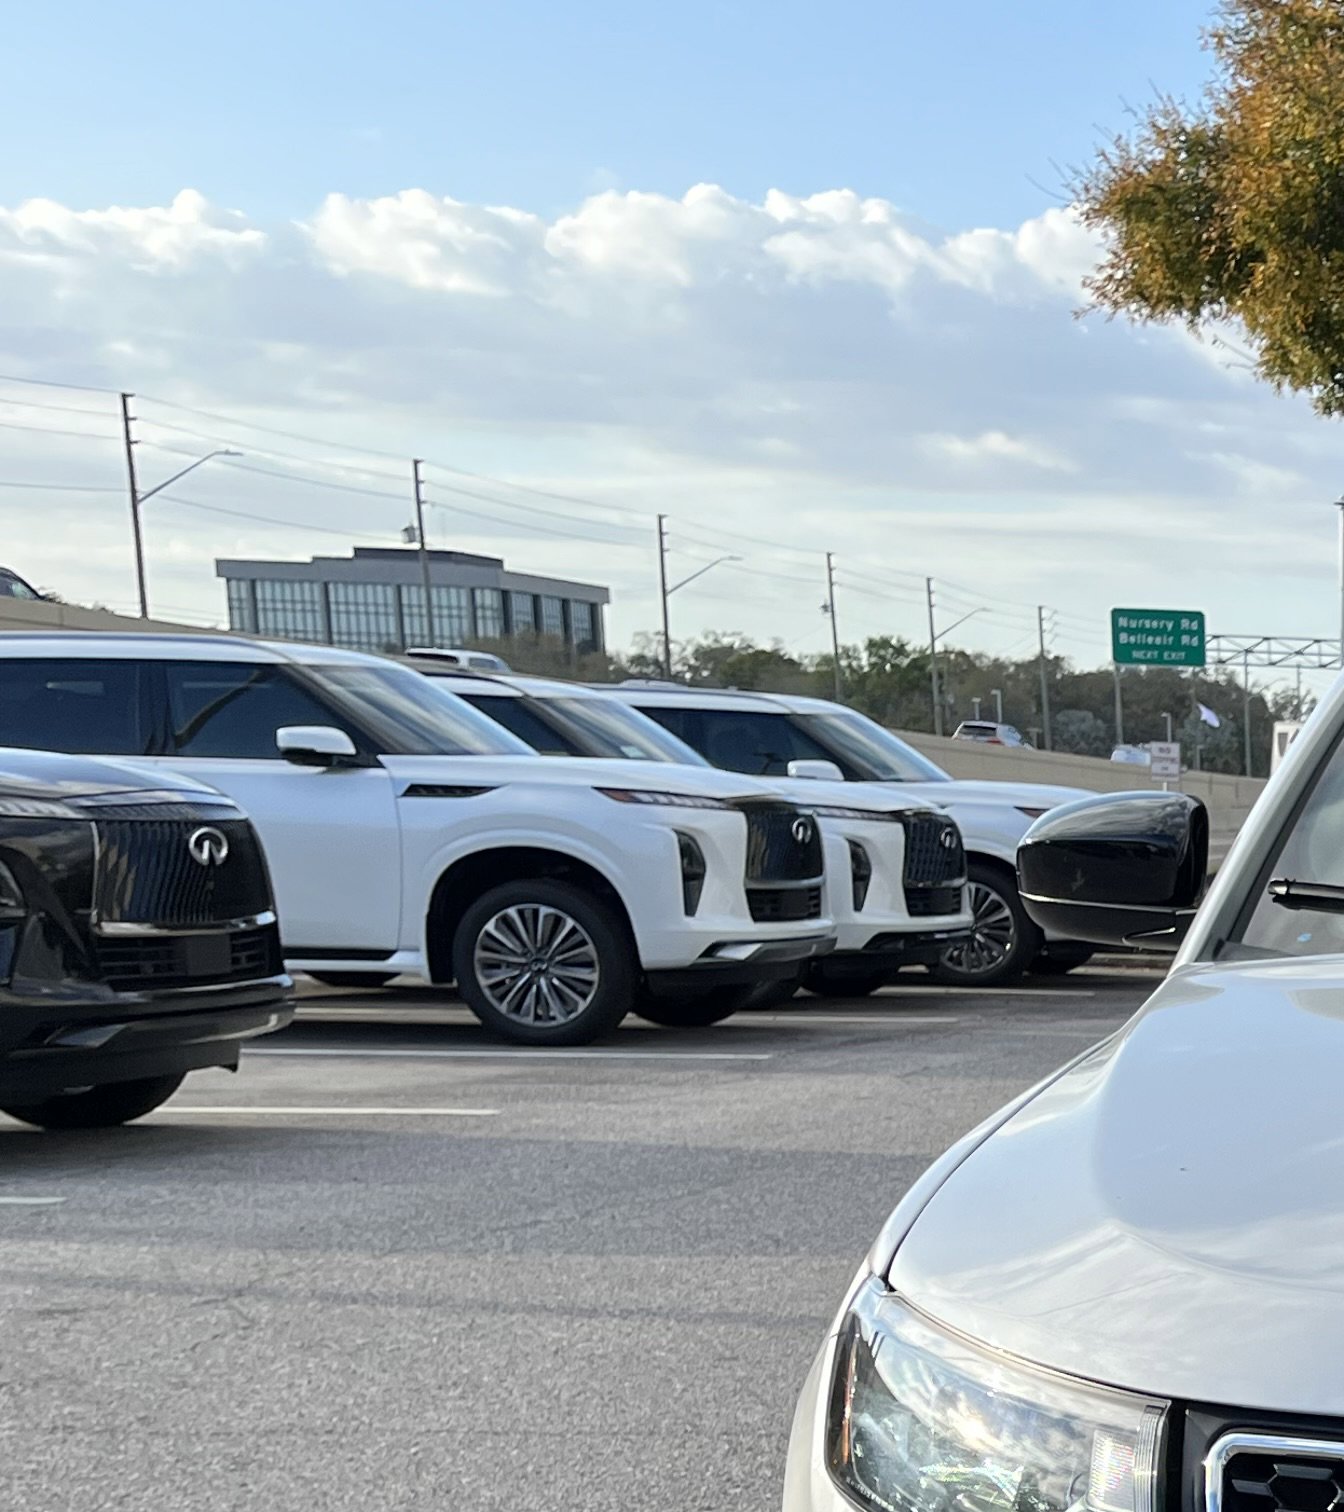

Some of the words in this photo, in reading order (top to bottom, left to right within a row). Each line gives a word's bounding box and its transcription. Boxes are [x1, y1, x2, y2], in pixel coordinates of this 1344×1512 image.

[1118, 616, 1175, 632] Nursery
[1180, 618, 1199, 631] Rd
[1119, 632, 1175, 646] Belleair
[1181, 634, 1199, 647] Rd
[1131, 650, 1159, 660] NEXT
[1163, 651, 1186, 661] EXIT
